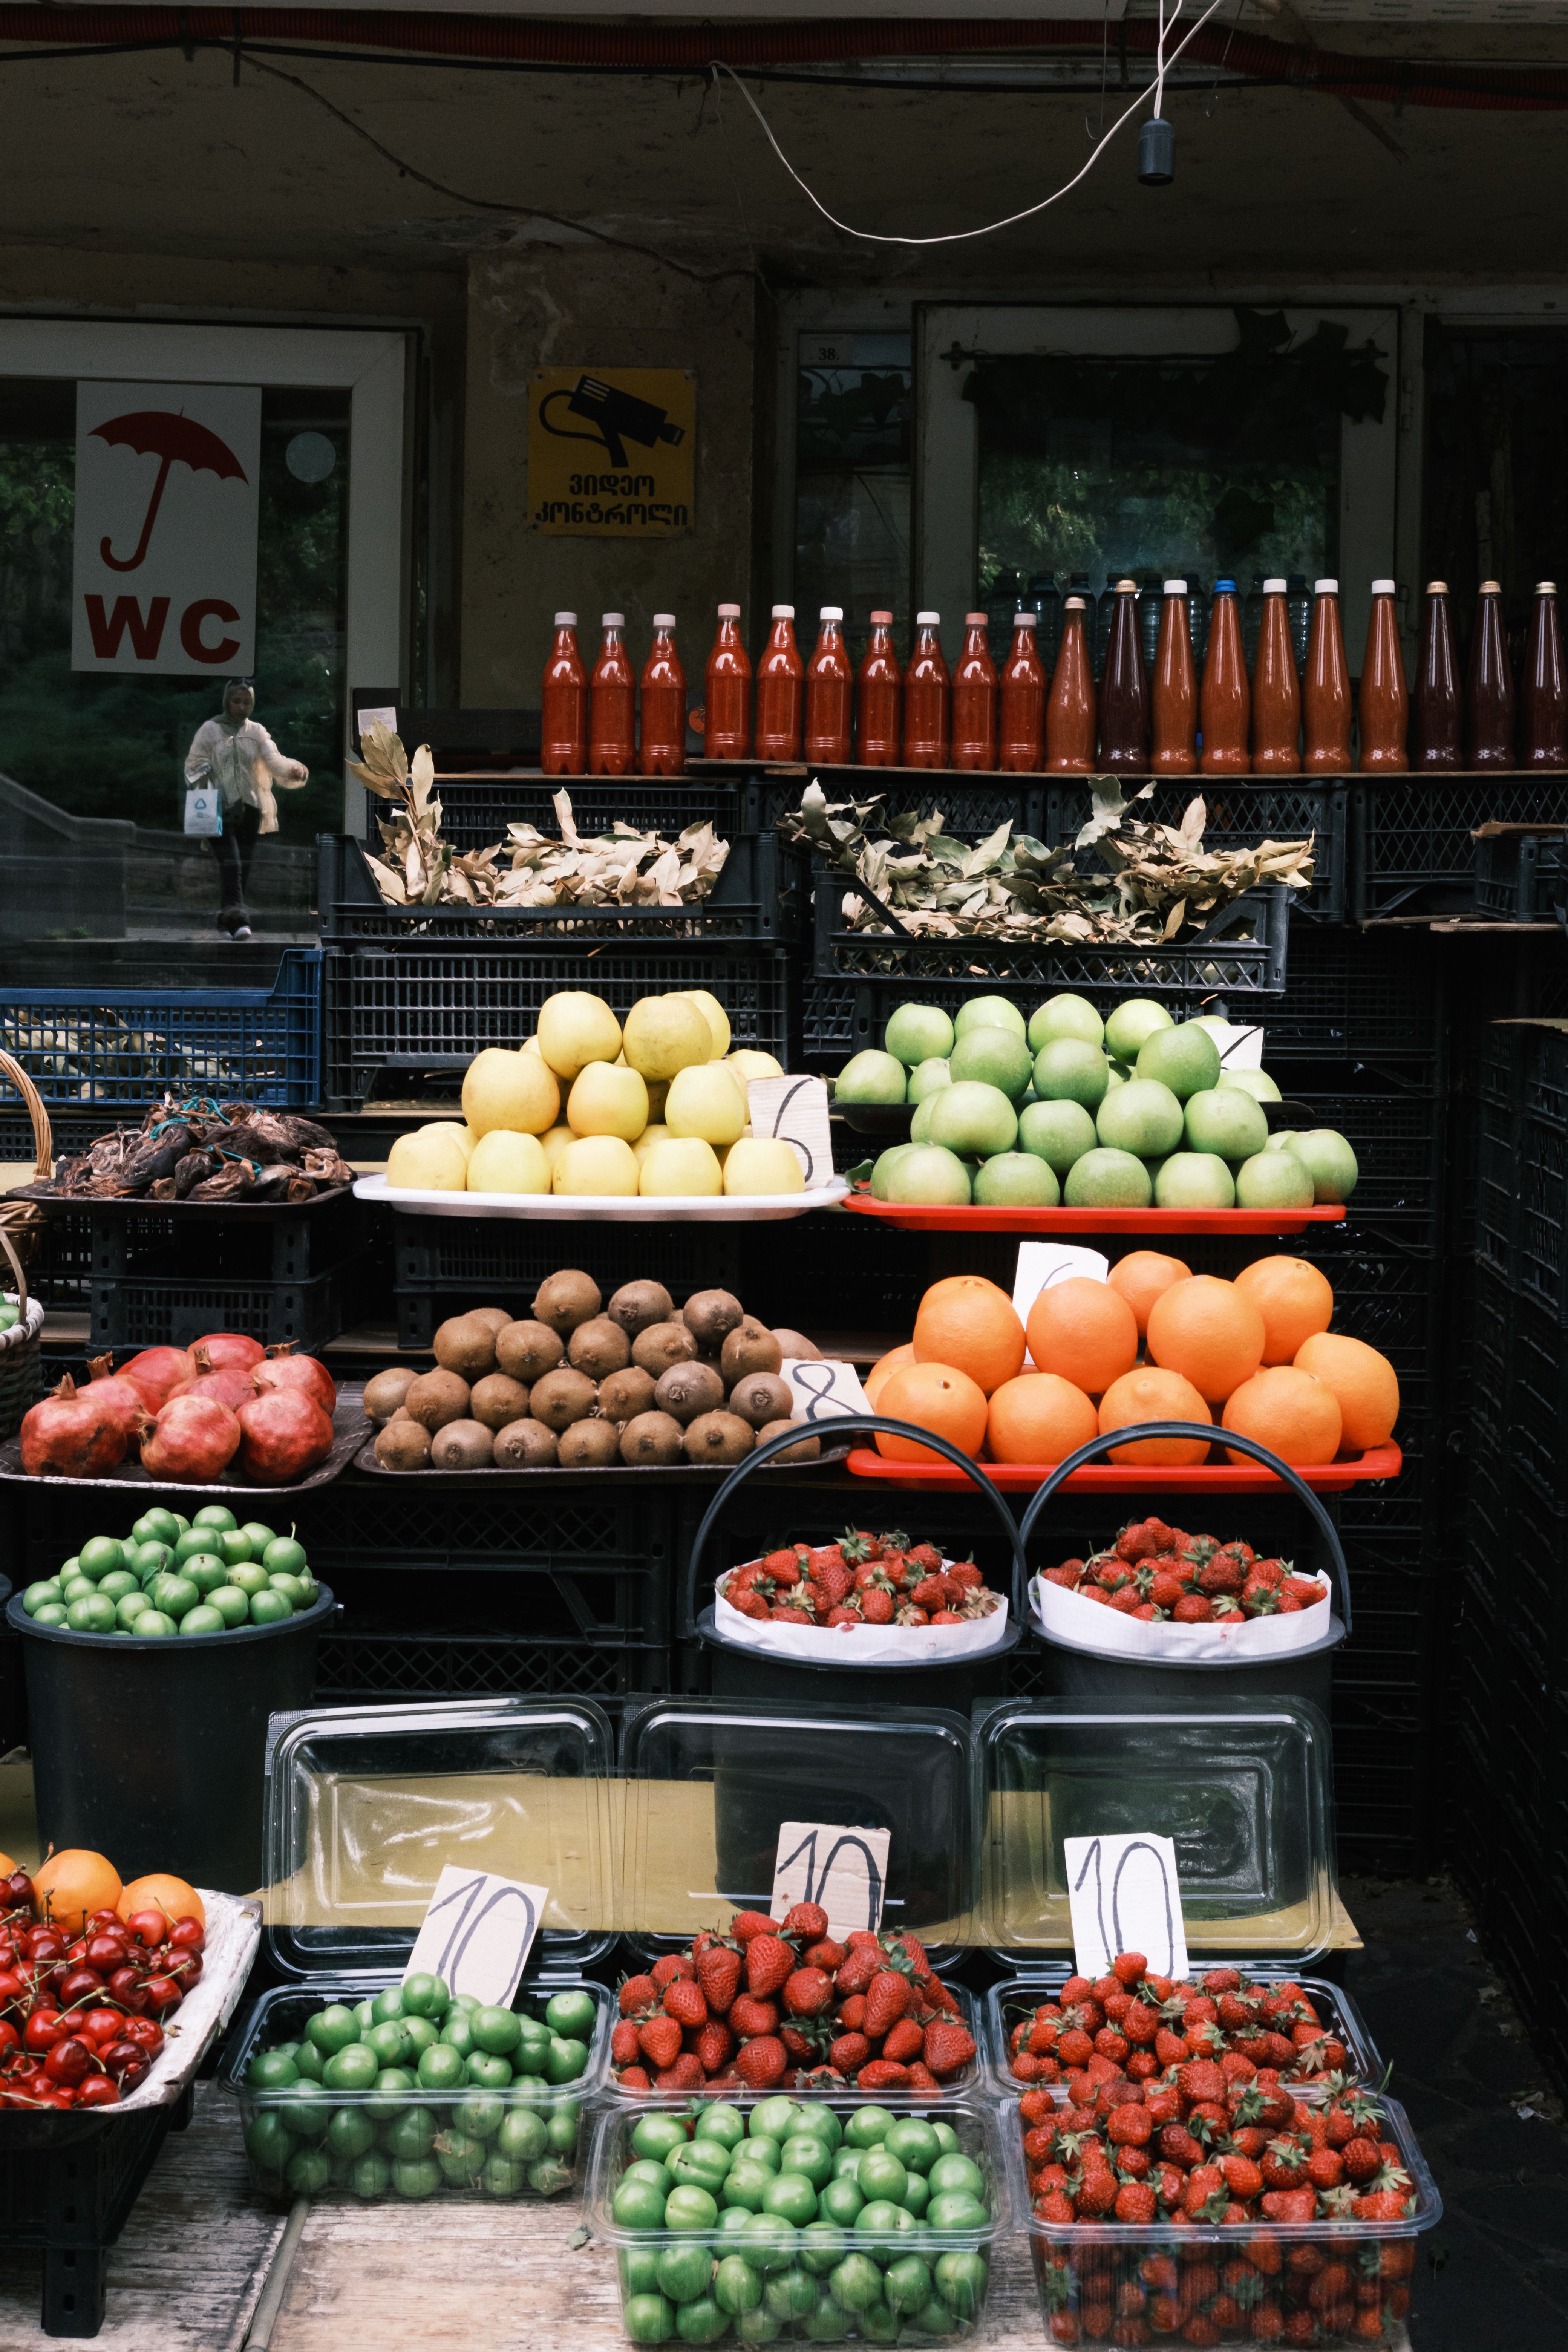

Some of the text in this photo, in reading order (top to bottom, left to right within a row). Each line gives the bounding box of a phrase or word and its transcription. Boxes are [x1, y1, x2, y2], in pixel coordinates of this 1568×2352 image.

[536, 501, 688, 526] კონტროლი
[569, 474, 654, 497] ვიდეო
[84, 594, 240, 664] WC
[792, 1363, 862, 1423] 8
[777, 1830, 882, 1932] 10
[1075, 1838, 1174, 1979] 10
[427, 1875, 535, 2006] 10
